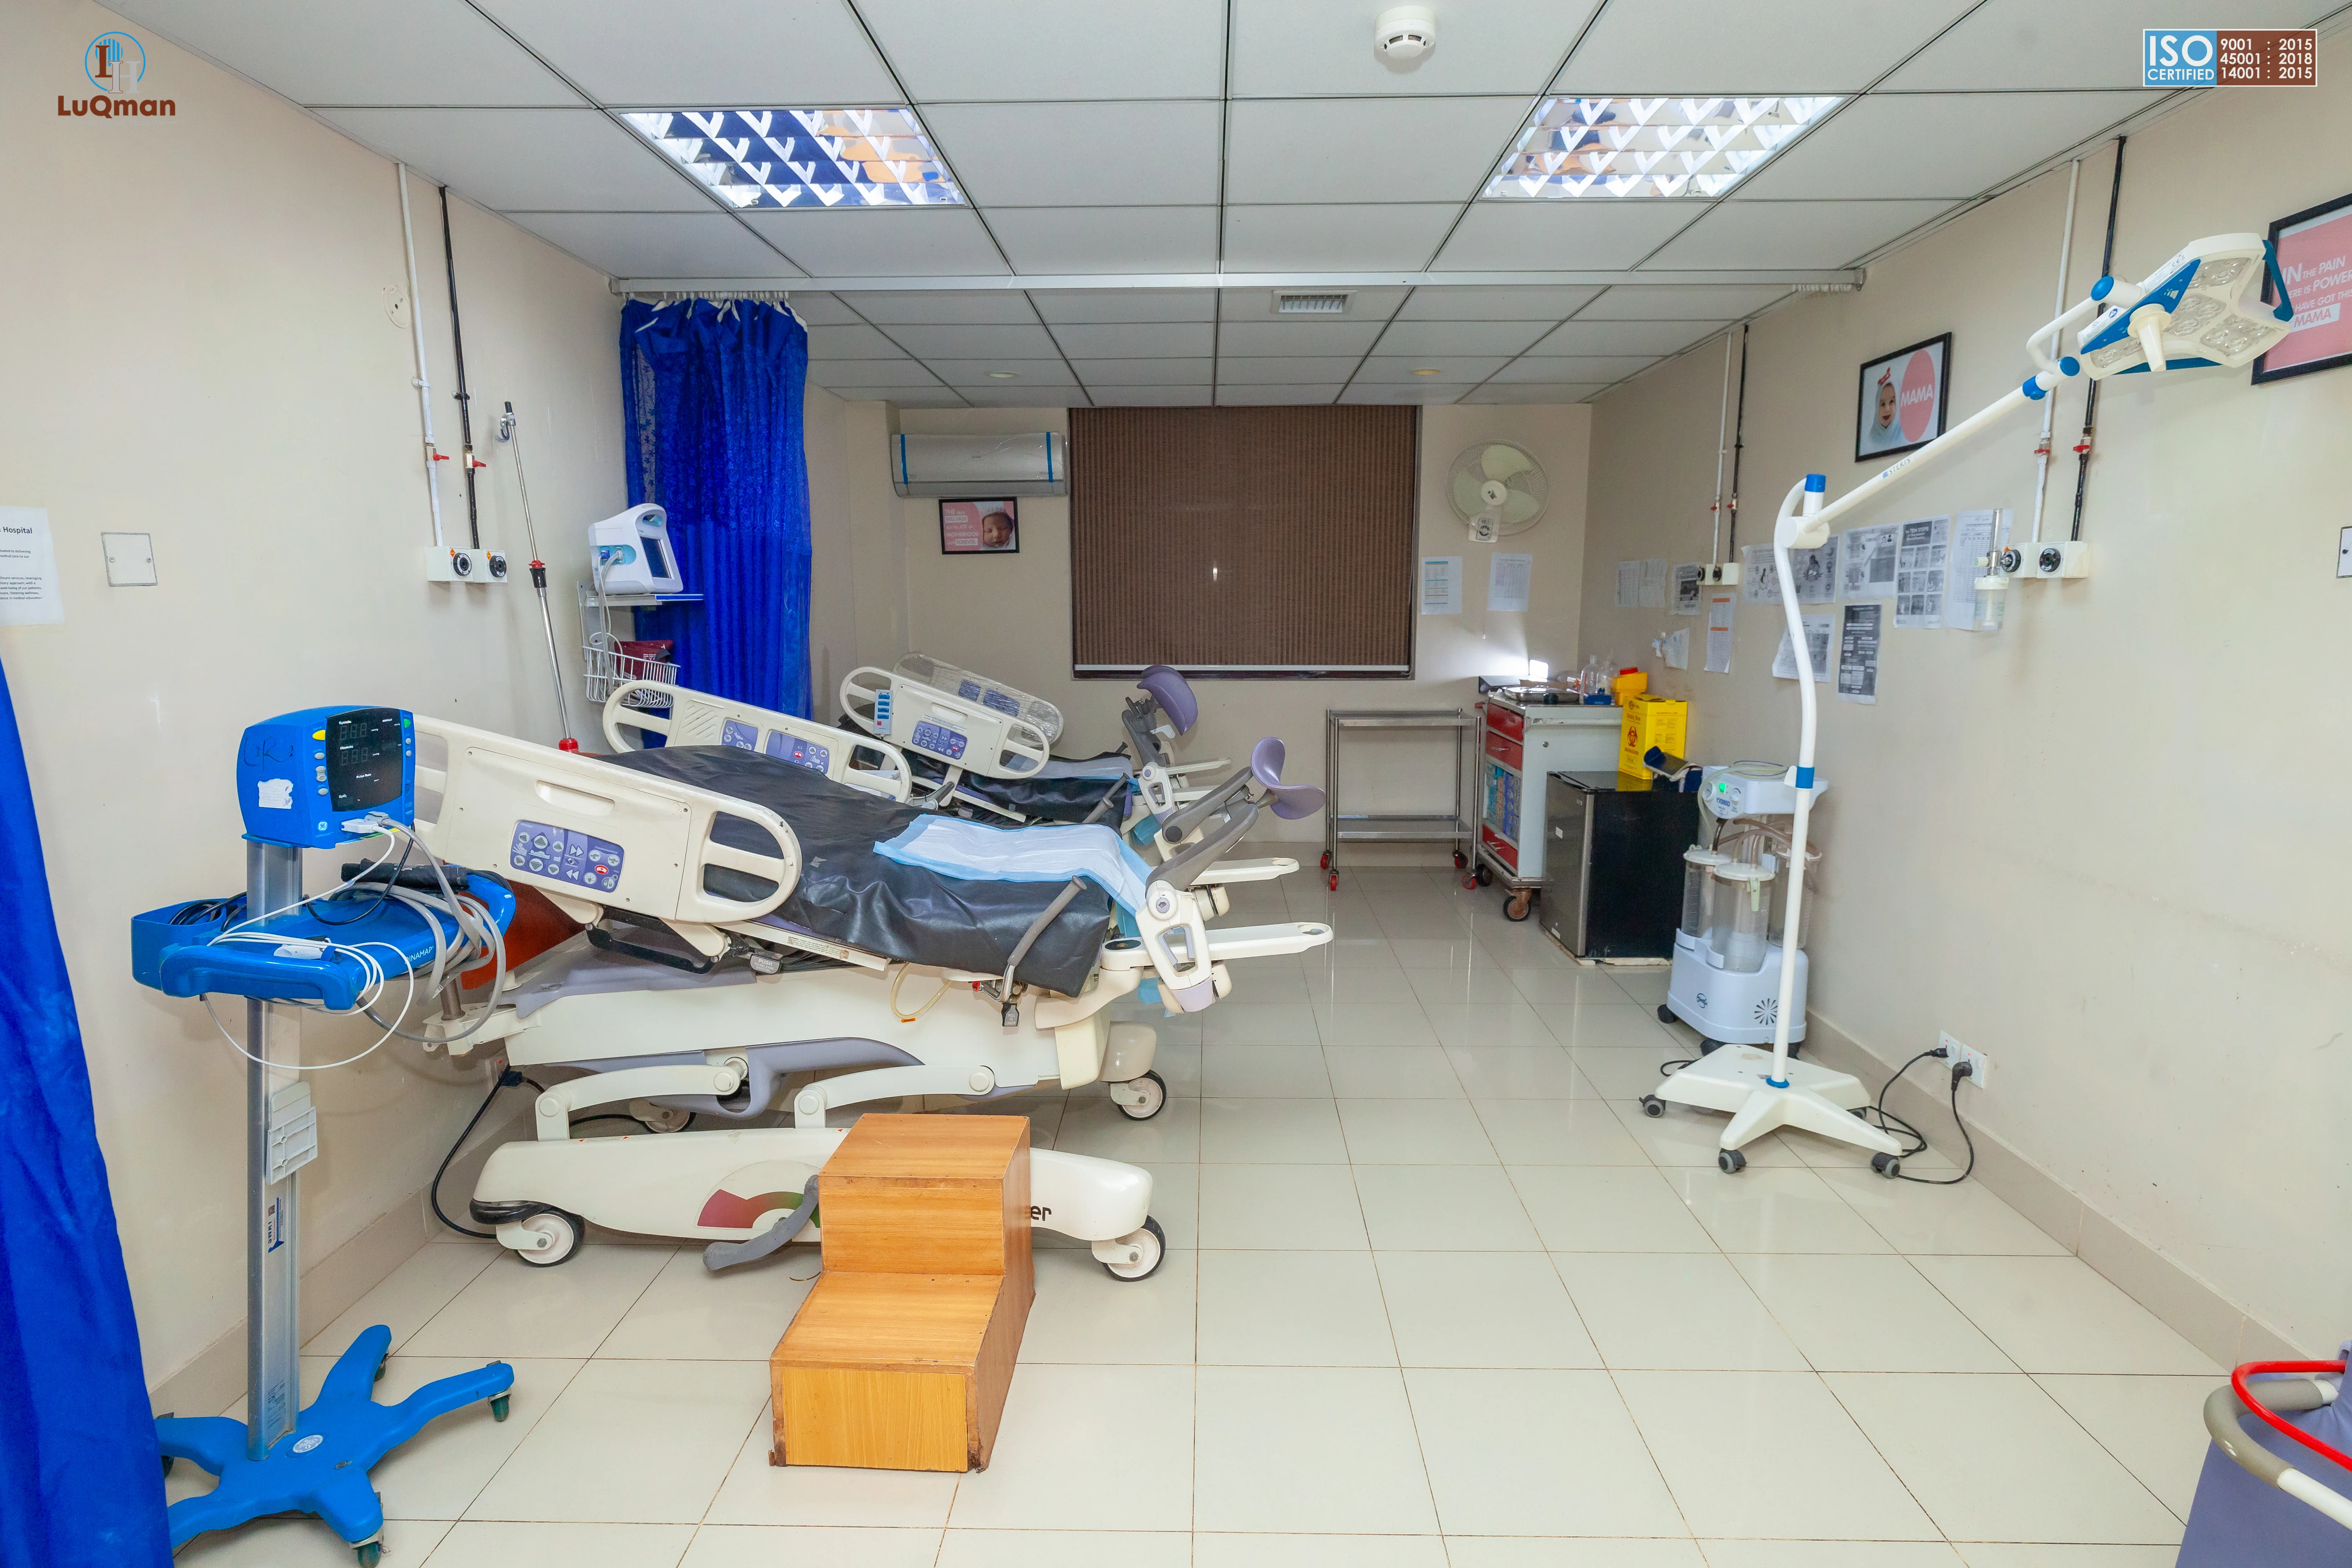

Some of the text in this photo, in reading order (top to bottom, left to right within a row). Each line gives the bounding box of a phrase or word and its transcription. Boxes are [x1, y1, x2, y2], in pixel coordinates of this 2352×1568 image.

[2282, 255, 2346, 285] IN THE PAIN
[2304, 285, 2311, 294] IS
[2295, 299, 2316, 312] HAVE
[2317, 294, 2336, 306] GOT
[2294, 308, 2331, 328] MAMA
[1900, 384, 1934, 407] MAMA
[1889, 456, 1911, 475] STERIS
[1031, 1205, 1052, 1222] er
